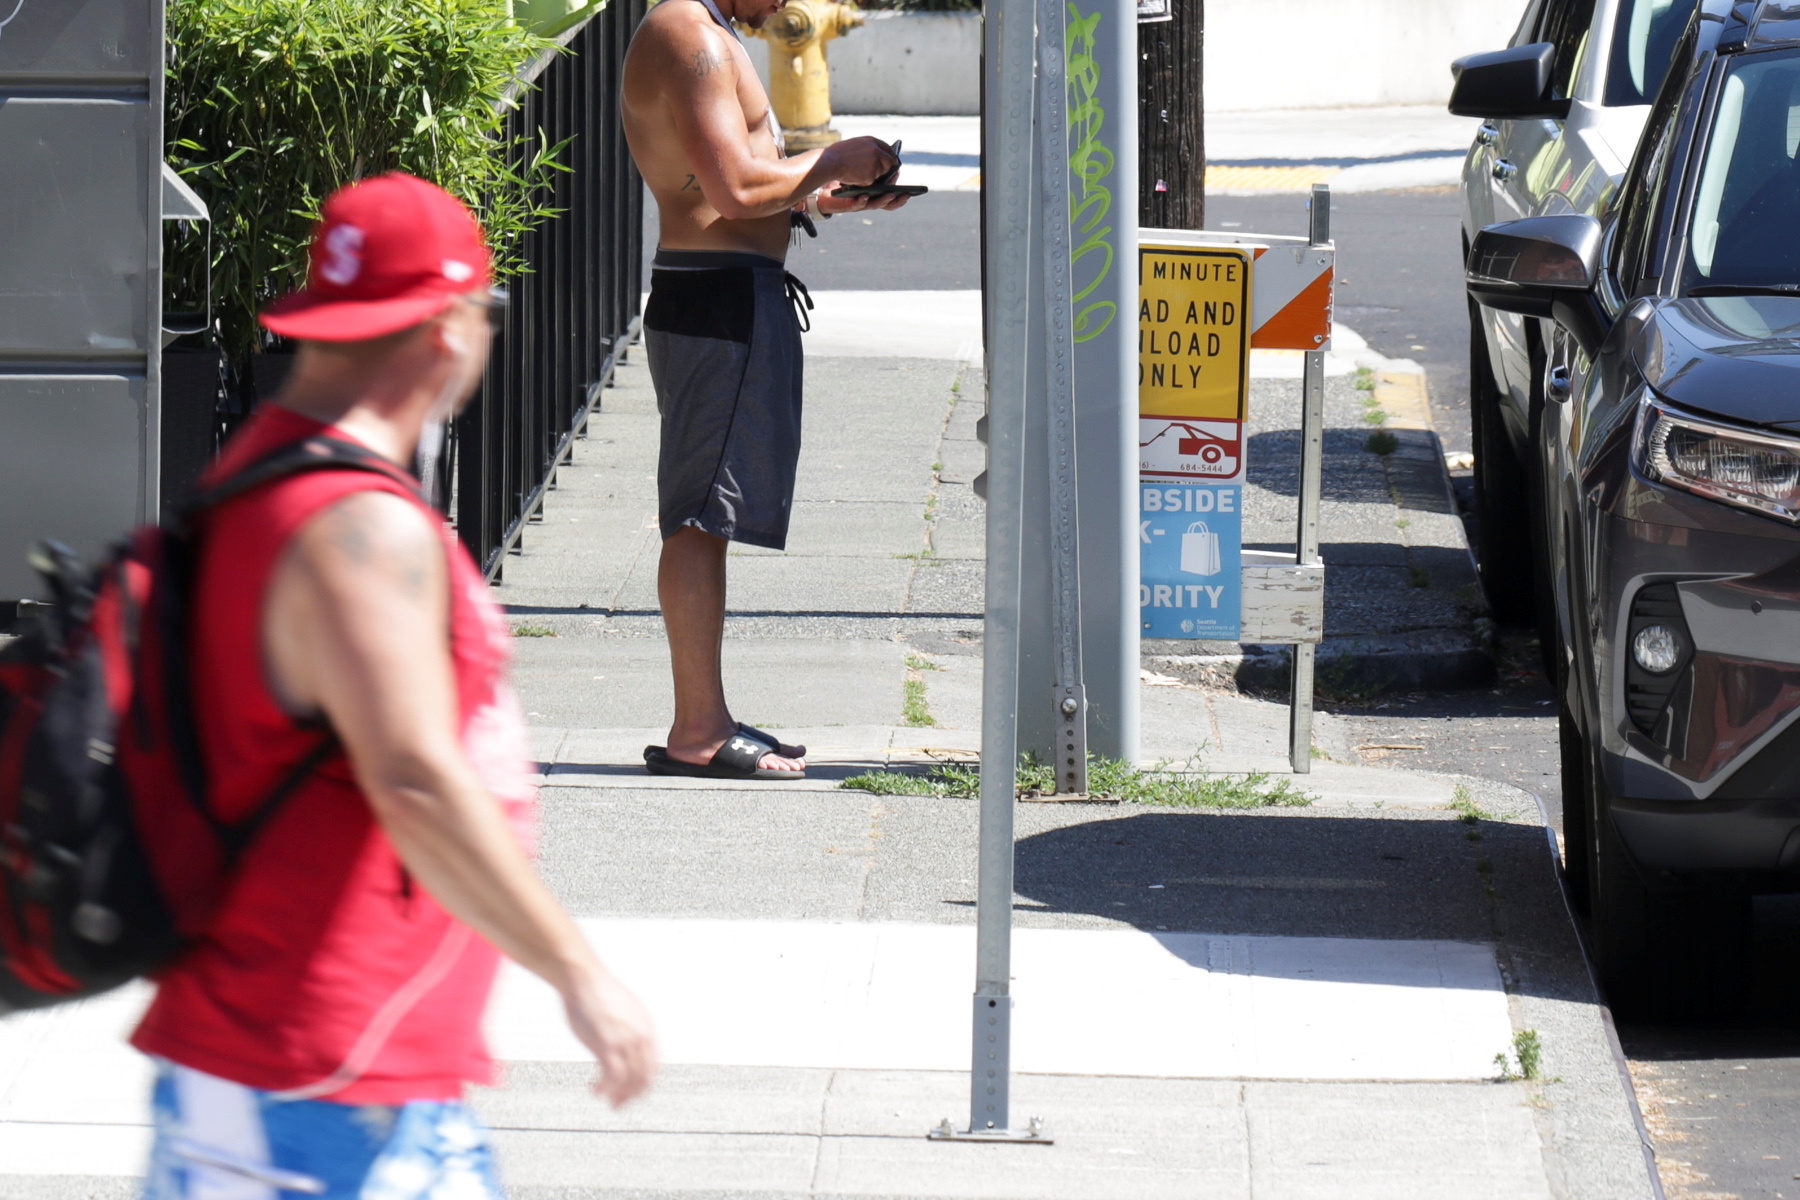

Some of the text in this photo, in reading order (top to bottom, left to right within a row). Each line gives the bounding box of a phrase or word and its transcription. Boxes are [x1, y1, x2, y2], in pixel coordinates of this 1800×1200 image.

[1153, 261, 1237, 282] MINUTE
[1185, 300, 1235, 326] AND
[1179, 462, 1223, 474] 684-5444
[1141, 488, 1235, 513] BSIDE
